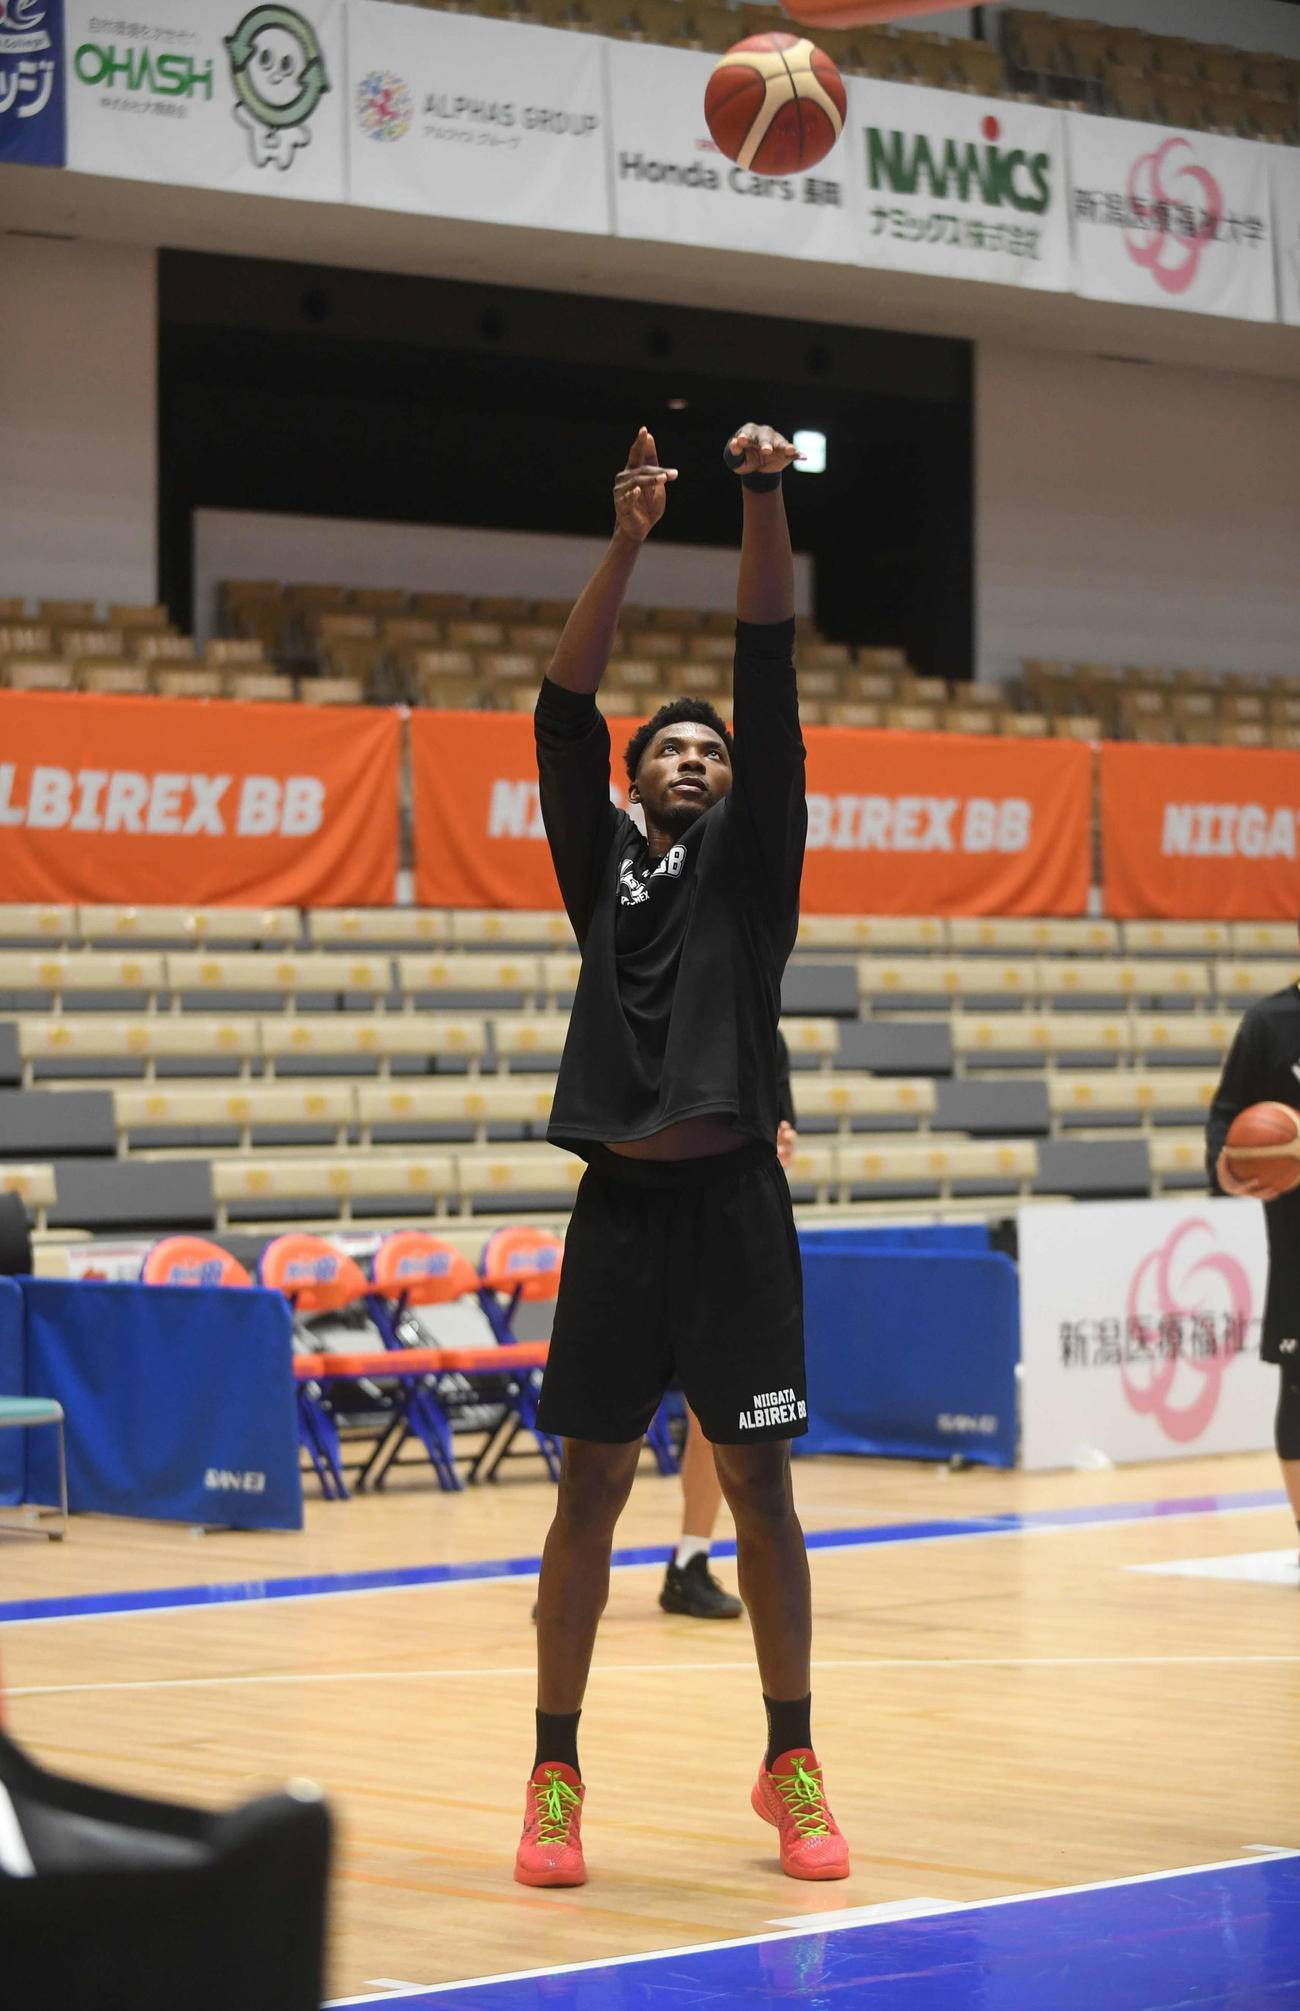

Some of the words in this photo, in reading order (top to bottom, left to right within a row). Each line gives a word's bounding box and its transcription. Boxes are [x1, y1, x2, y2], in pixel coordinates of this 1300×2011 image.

[422, 92, 516, 127] ALPHAS
[520, 106, 600, 137] GROUP
[617, 151, 720, 191] Honda
[727, 166, 795, 202] Cars
[0, 763, 233, 837] LBIREX
[236, 774, 326, 838] BB
[805, 793, 960, 853] BIREX
[960, 797, 1033, 855] BB
[1161, 802, 1300, 861] NIIGA
[1059, 1309, 1263, 1368] 新潟医療福祉
[739, 1402, 797, 1430] ALBIREX
[753, 1388, 796, 1409] NIIGATA
